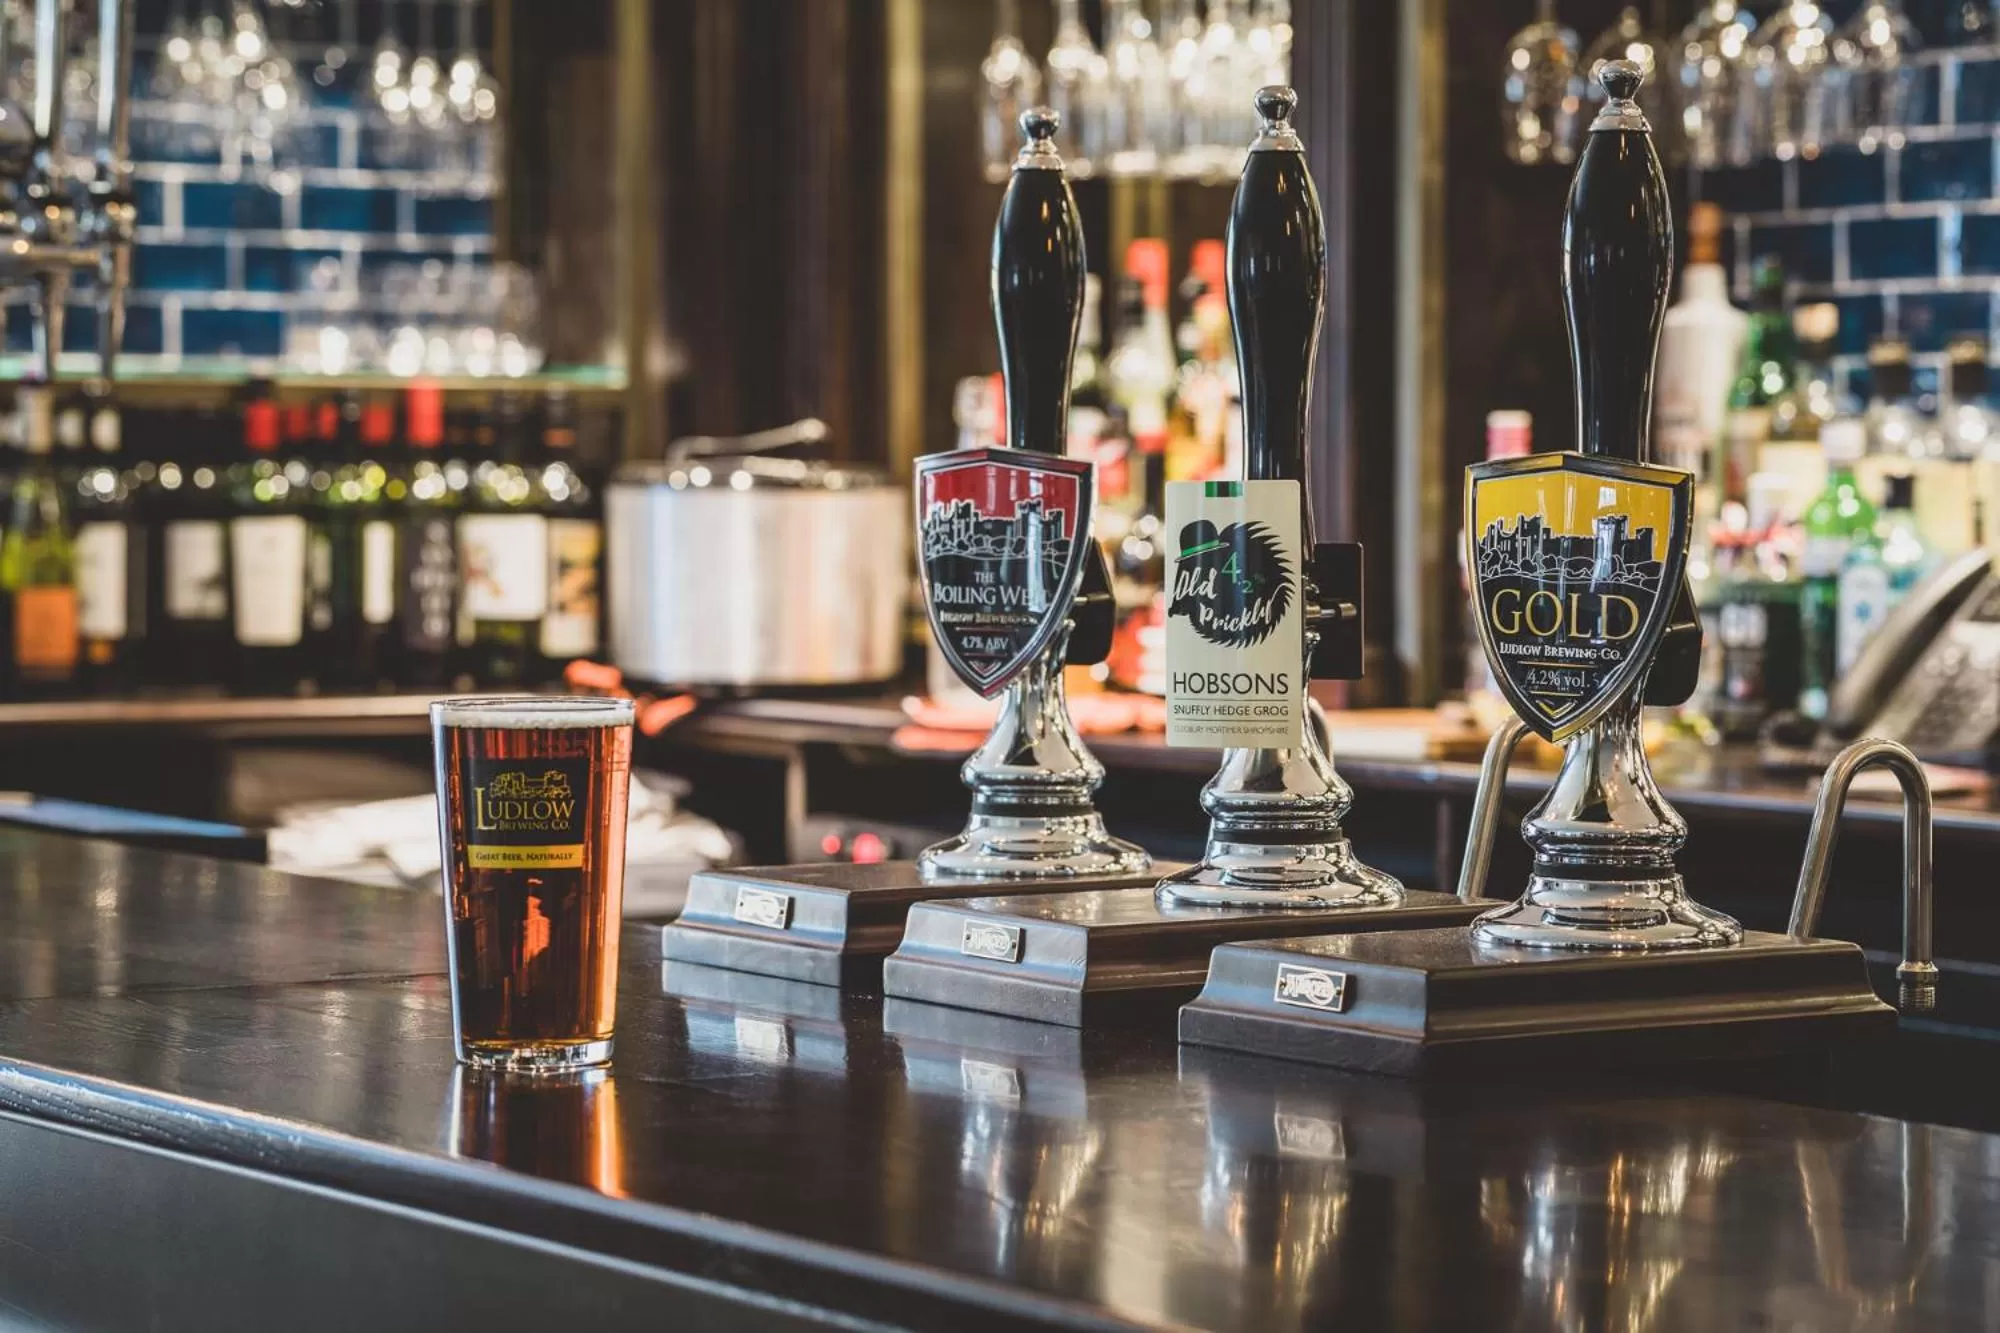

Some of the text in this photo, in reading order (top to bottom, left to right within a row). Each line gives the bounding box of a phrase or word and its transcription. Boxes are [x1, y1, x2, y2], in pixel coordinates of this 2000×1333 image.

[974, 571, 995, 584] THE
[1174, 566, 1217, 601] Old
[934, 582, 996, 605] BOILING
[1491, 588, 1640, 641] GOLD
[985, 637, 1009, 651] ABV
[1500, 642, 1541, 656] LUDLOW
[1544, 644, 1597, 660] BREWING
[1173, 671, 1289, 695] HOBSONS
[1526, 668, 1590, 688] 4.2% vol.
[1173, 704, 1289, 717] SNUFFLY HEDGE GROG
[474, 787, 576, 831] LUDLOW
